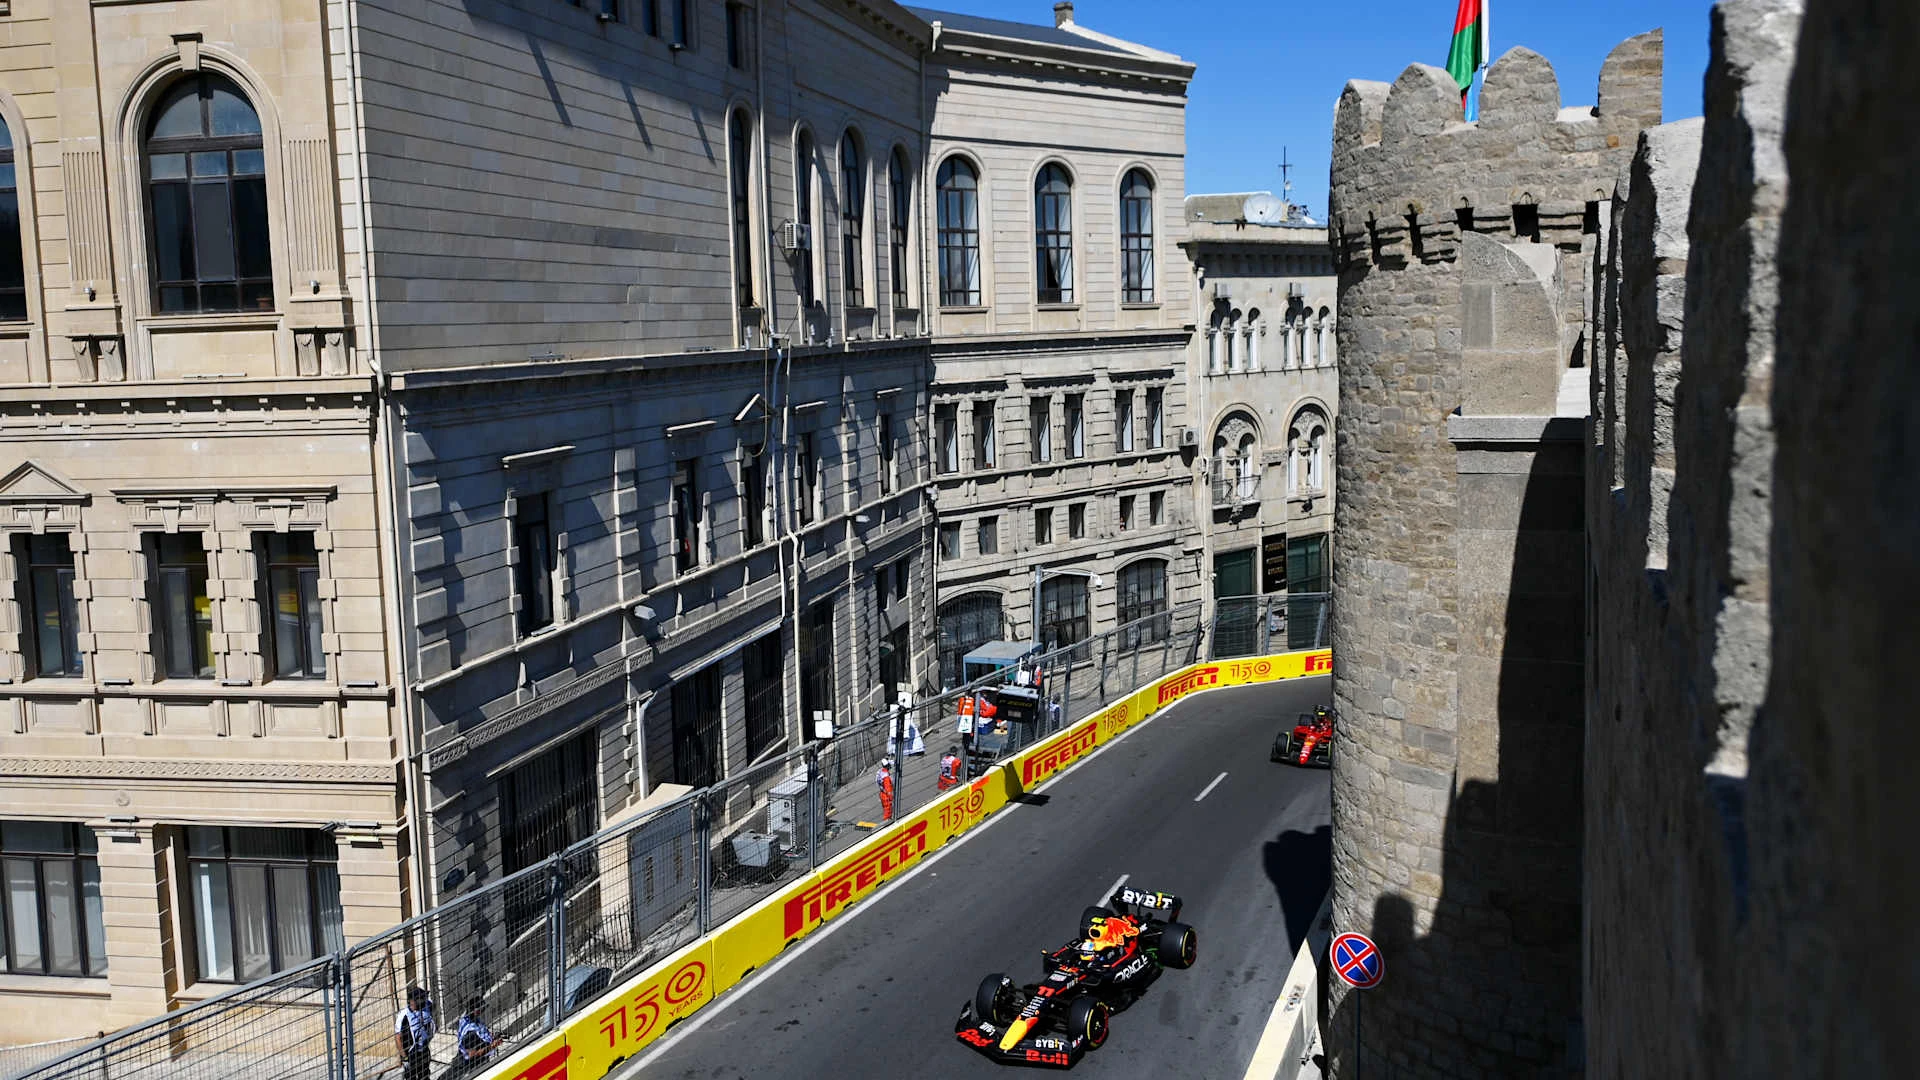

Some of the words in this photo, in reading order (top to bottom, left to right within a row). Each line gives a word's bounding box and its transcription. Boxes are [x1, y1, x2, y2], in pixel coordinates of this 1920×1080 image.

[1158, 667, 1219, 704] PIRELLI
[1023, 721, 1098, 786] PIRELLI
[939, 788, 985, 831] 150
[784, 820, 928, 940] PIRELLI
[1122, 889, 1173, 909] BYBIT
[1113, 954, 1148, 983] ORACLE
[600, 961, 705, 1048] 150
[669, 990, 704, 1018] YEARS
[1037, 986, 1055, 997] 11
[1025, 1049, 1069, 1065] Bull
[1035, 1038, 1065, 1051] BYBIT
